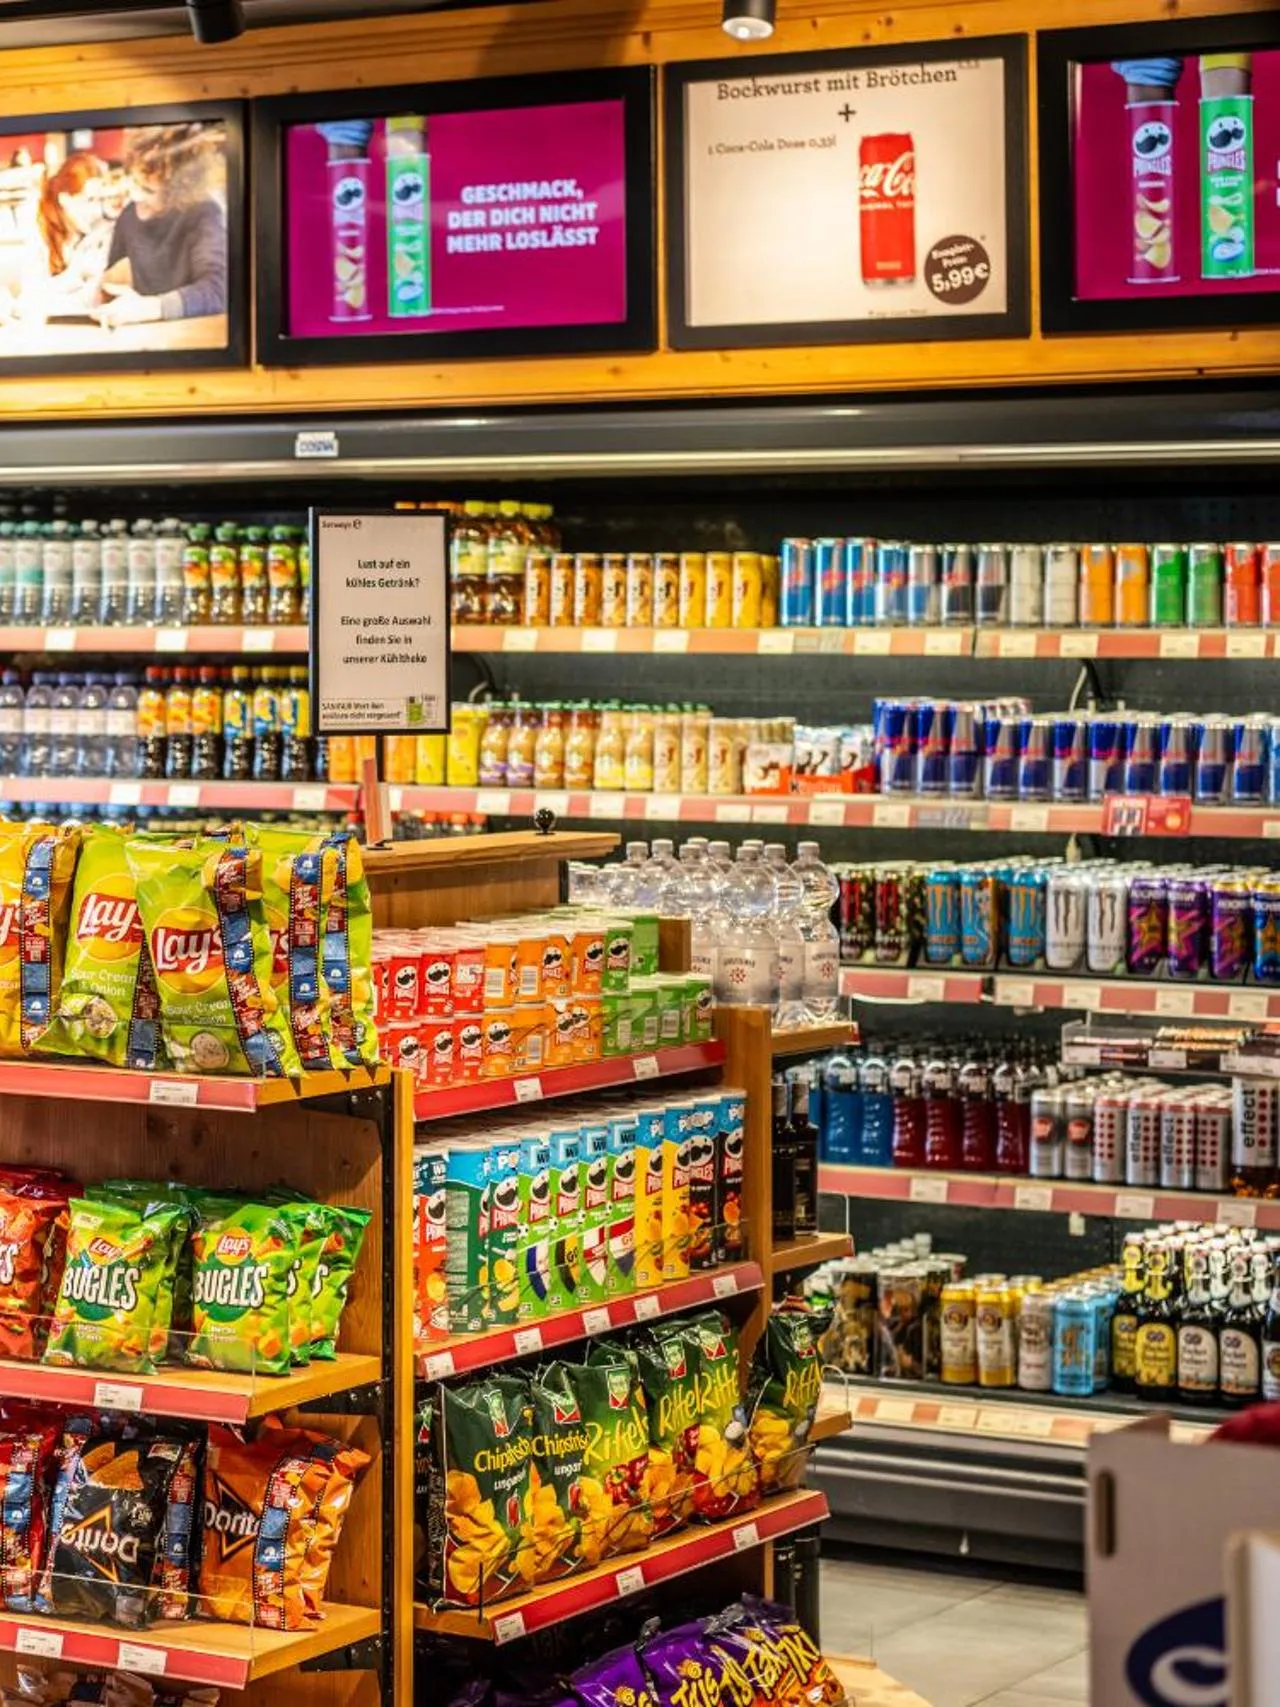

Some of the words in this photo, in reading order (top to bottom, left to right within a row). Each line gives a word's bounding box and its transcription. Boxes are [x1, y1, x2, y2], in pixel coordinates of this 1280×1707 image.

[717, 74, 821, 101] Bockwurst
[826, 71, 865, 93] mit
[866, 64, 958, 88] Brötchen
[461, 179, 584, 204] GESCHMACK,
[447, 210, 487, 229] DER
[490, 206, 536, 226] DICH
[539, 202, 598, 223] NICHT
[447, 233, 502, 254] MEHR
[505, 225, 599, 250] LOSLÄSST
[932, 262, 989, 293] 5,99€
[358, 559, 377, 569] Lust
[379, 558, 394, 569] auf
[396, 559, 411, 569] ein
[346, 577, 376, 588] kühles
[378, 577, 420, 588] Getränk?
[341, 616, 361, 626] Eine
[363, 616, 390, 627] große
[392, 615, 431, 626] Auswahl
[355, 634, 386, 645] finden
[388, 634, 402, 645] Sie
[404, 635, 412, 645] in
[343, 655, 379, 664] unserer
[380, 653, 427, 664] Kühltheke
[1240, 1088, 1256, 1148] effect
[62, 1264, 142, 1312] BUGLES
[194, 1264, 271, 1308] BUGLES
[204, 1502, 260, 1536] Dorit
[61, 1523, 140, 1562] Dorito
